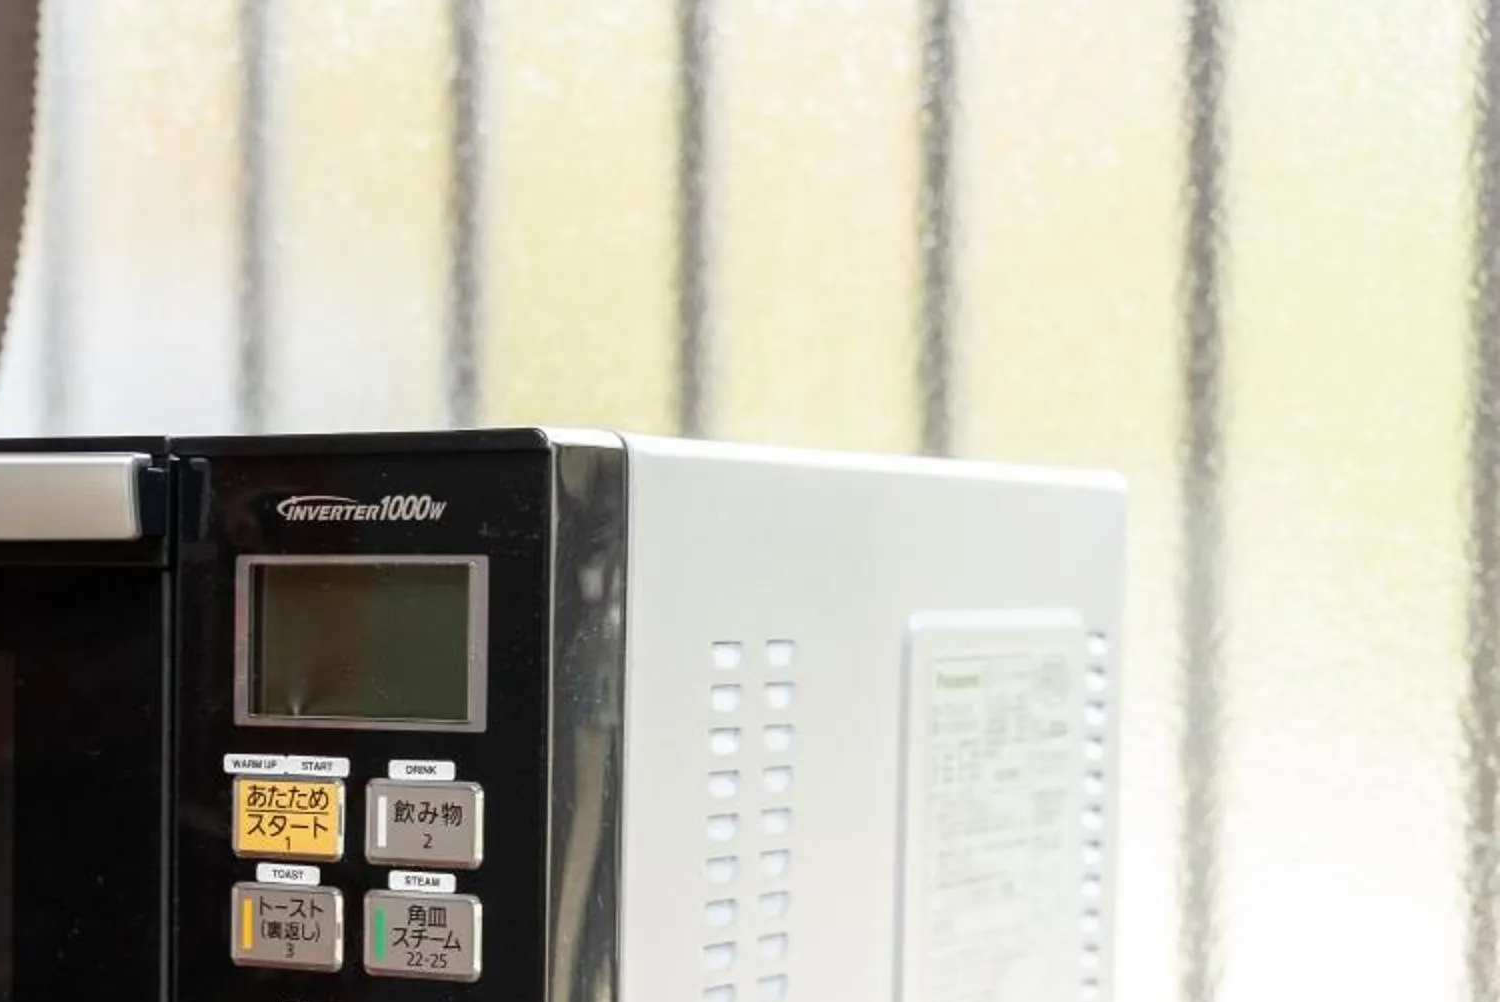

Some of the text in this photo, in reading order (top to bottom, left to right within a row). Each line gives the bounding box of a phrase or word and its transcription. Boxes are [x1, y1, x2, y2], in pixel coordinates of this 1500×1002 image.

[263, 760, 279, 769] UP
[301, 761, 333, 771] START
[405, 766, 437, 776] DRINK
[247, 784, 329, 810] あたため
[393, 799, 464, 828] 飲み物
[247, 813, 329, 839] スタート
[284, 836, 292, 850] 1
[422, 833, 433, 849] 2
[271, 869, 304, 881] TOAST
[404, 875, 442, 887] STEAM
[258, 895, 325, 918] トースト
[406, 904, 448, 928] 角皿
[260, 920, 322, 942] (裏返し)
[392, 928, 462, 951] スチーム
[285, 942, 295, 959] 3
[406, 951, 448, 969] 22-25
